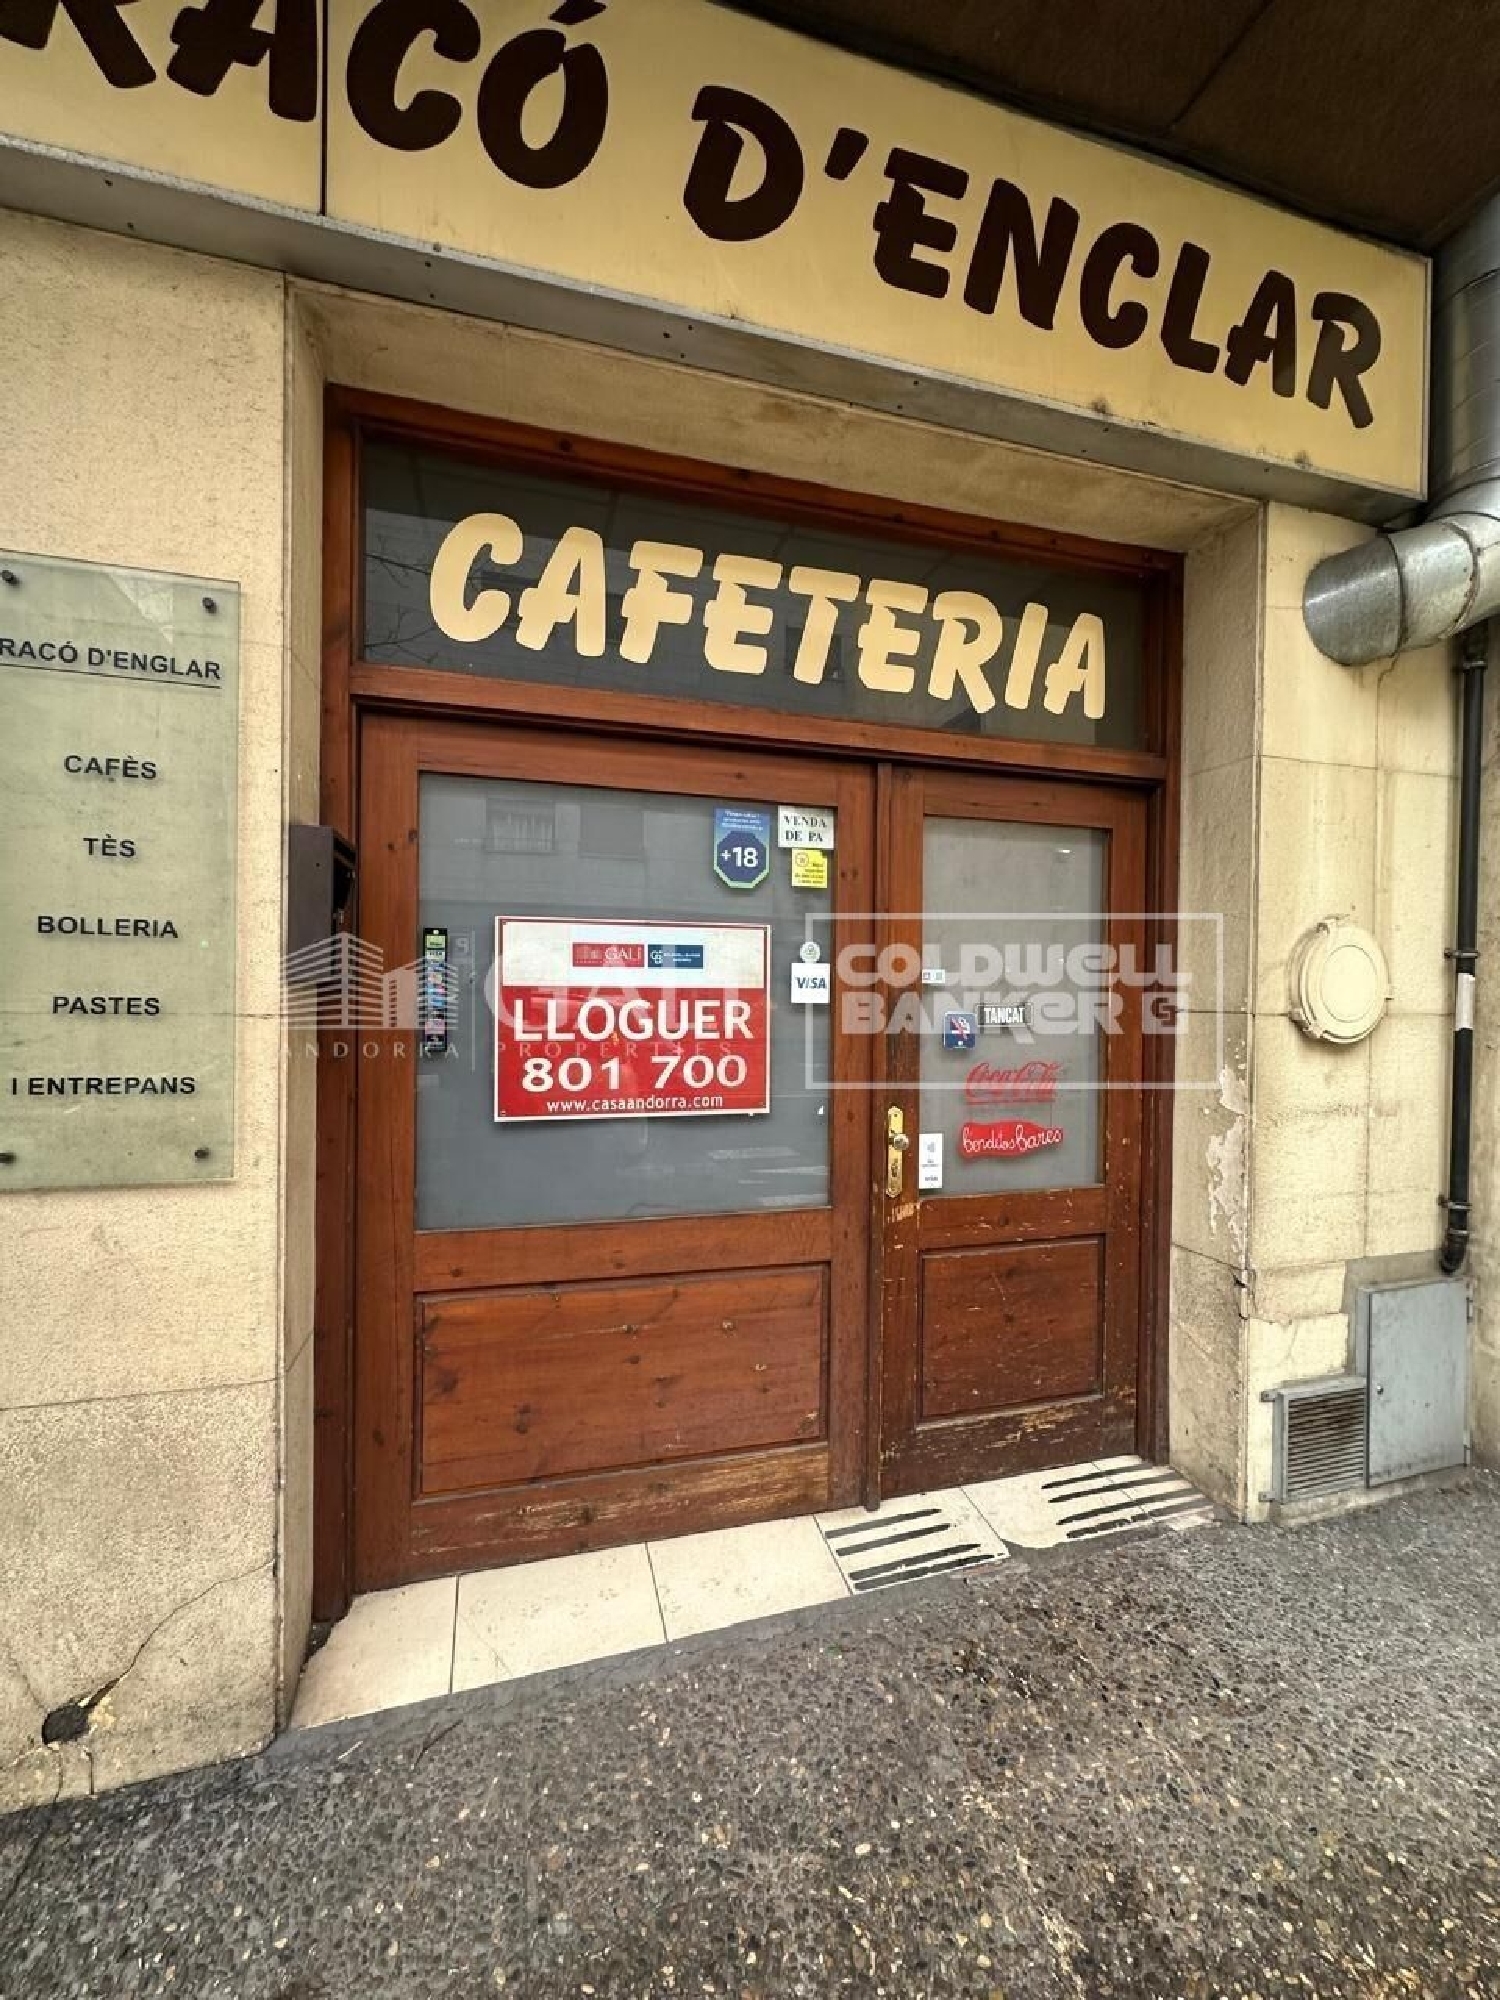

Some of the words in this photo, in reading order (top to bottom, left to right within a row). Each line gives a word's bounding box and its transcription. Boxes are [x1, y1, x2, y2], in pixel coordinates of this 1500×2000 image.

[683, 85, 1382, 430] D'ENCLAR
[429, 512, 1105, 720] CAFETERIA
[0, 638, 78, 664] RACÓ
[88, 647, 221, 681] D'ENGLAR
[63, 754, 157, 780] CAFÈS
[784, 815, 828, 828] VENDA
[83, 833, 136, 858] TÈS
[785, 830, 803, 842] DE
[808, 831, 824, 843] PA
[721, 846, 758, 867] +18
[37, 915, 178, 939] BOLLERIA
[796, 976, 827, 989] VISA
[52, 996, 160, 1016] PASTES
[983, 1007, 1025, 1024] TANCAT
[513, 997, 755, 1042] LLOGUER
[521, 1056, 621, 1093] 801
[650, 1053, 748, 1090] 700
[12, 1077, 18, 1096] I
[27, 1076, 196, 1096] ENTREPANS
[546, 1093, 724, 1113] www.casaandorra.com
